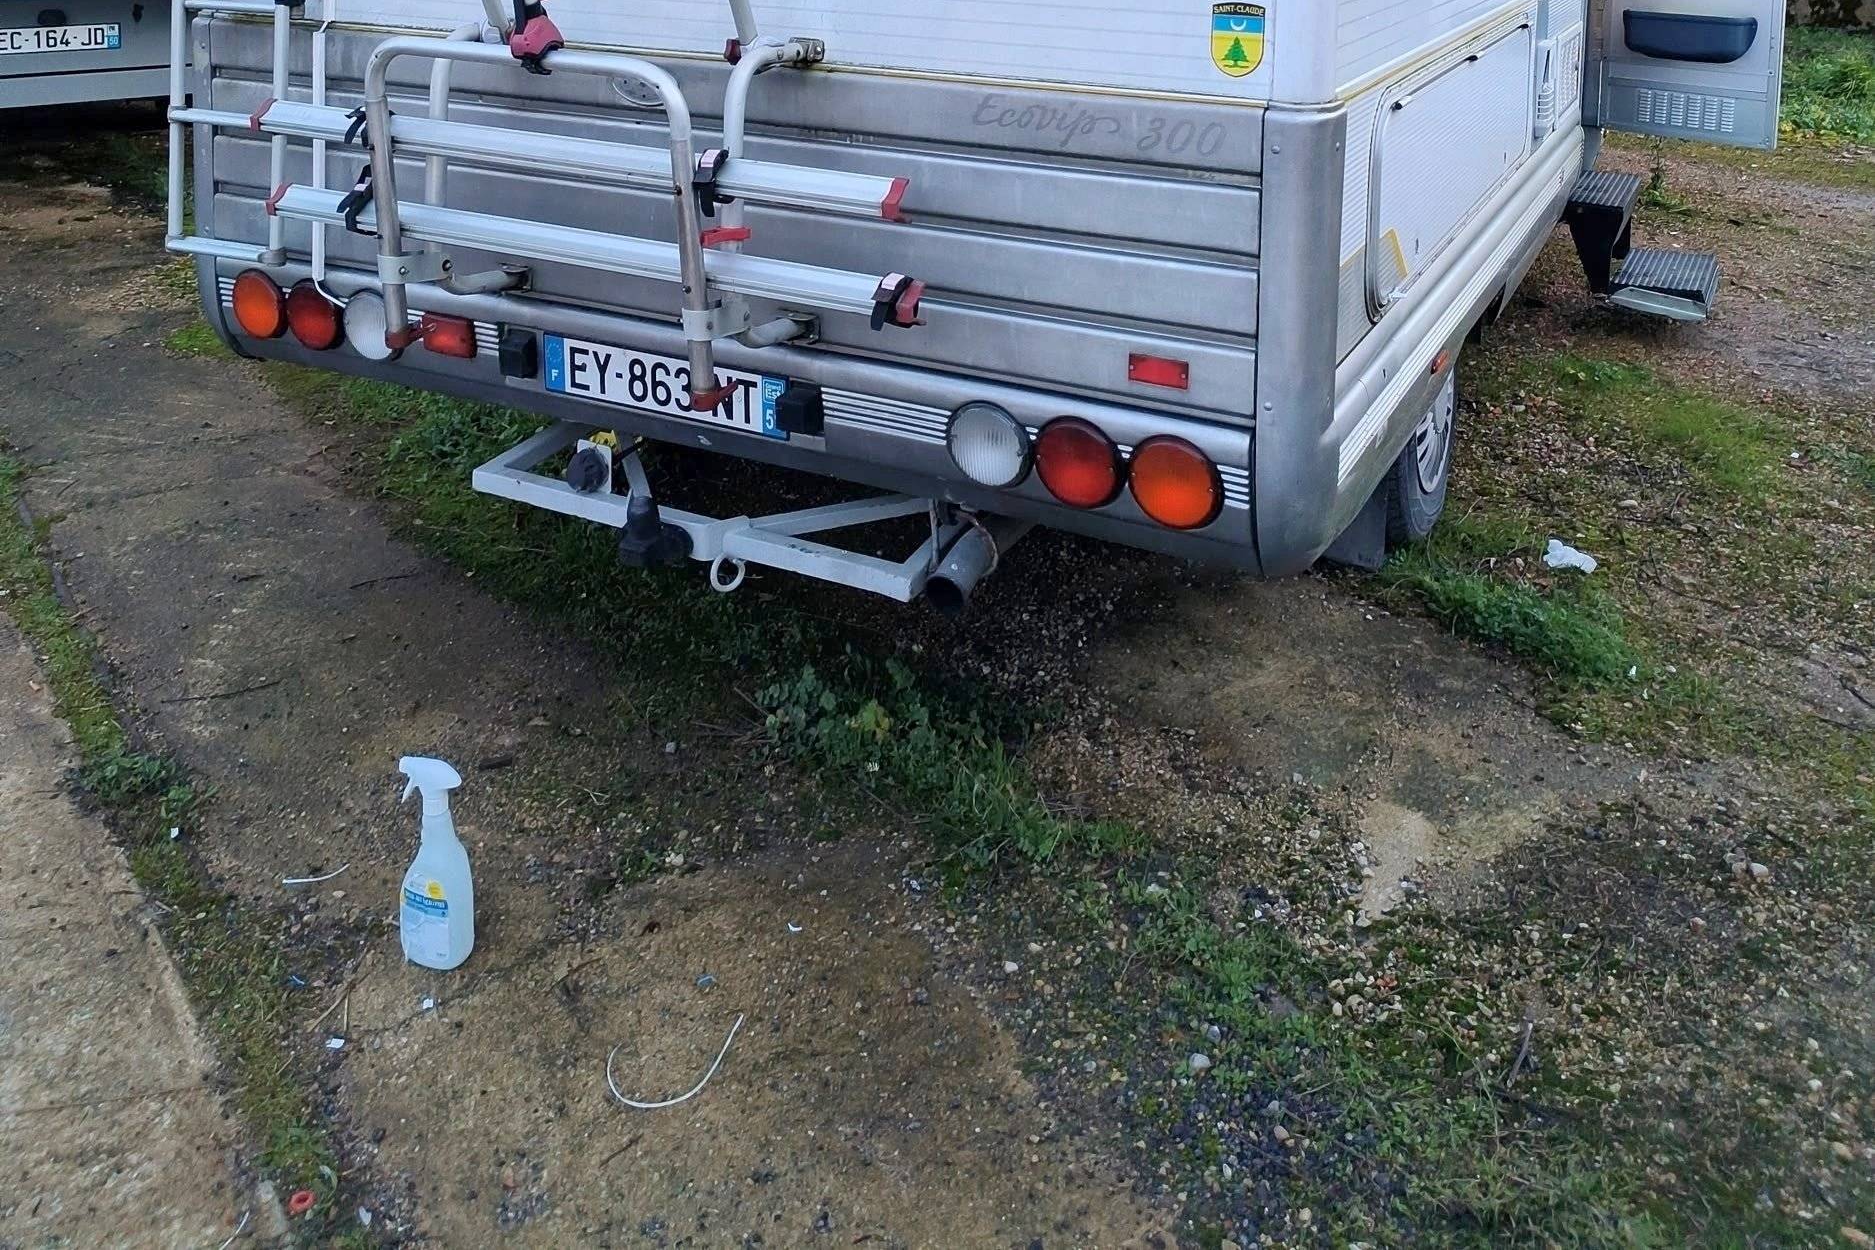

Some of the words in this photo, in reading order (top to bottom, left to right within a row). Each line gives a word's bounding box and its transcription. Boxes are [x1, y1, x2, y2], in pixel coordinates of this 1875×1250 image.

[1213, 4, 1265, 17] SAINT-CLAUDE
[551, 369, 560, 382] F
[568, 345, 758, 425] EY-863NT
